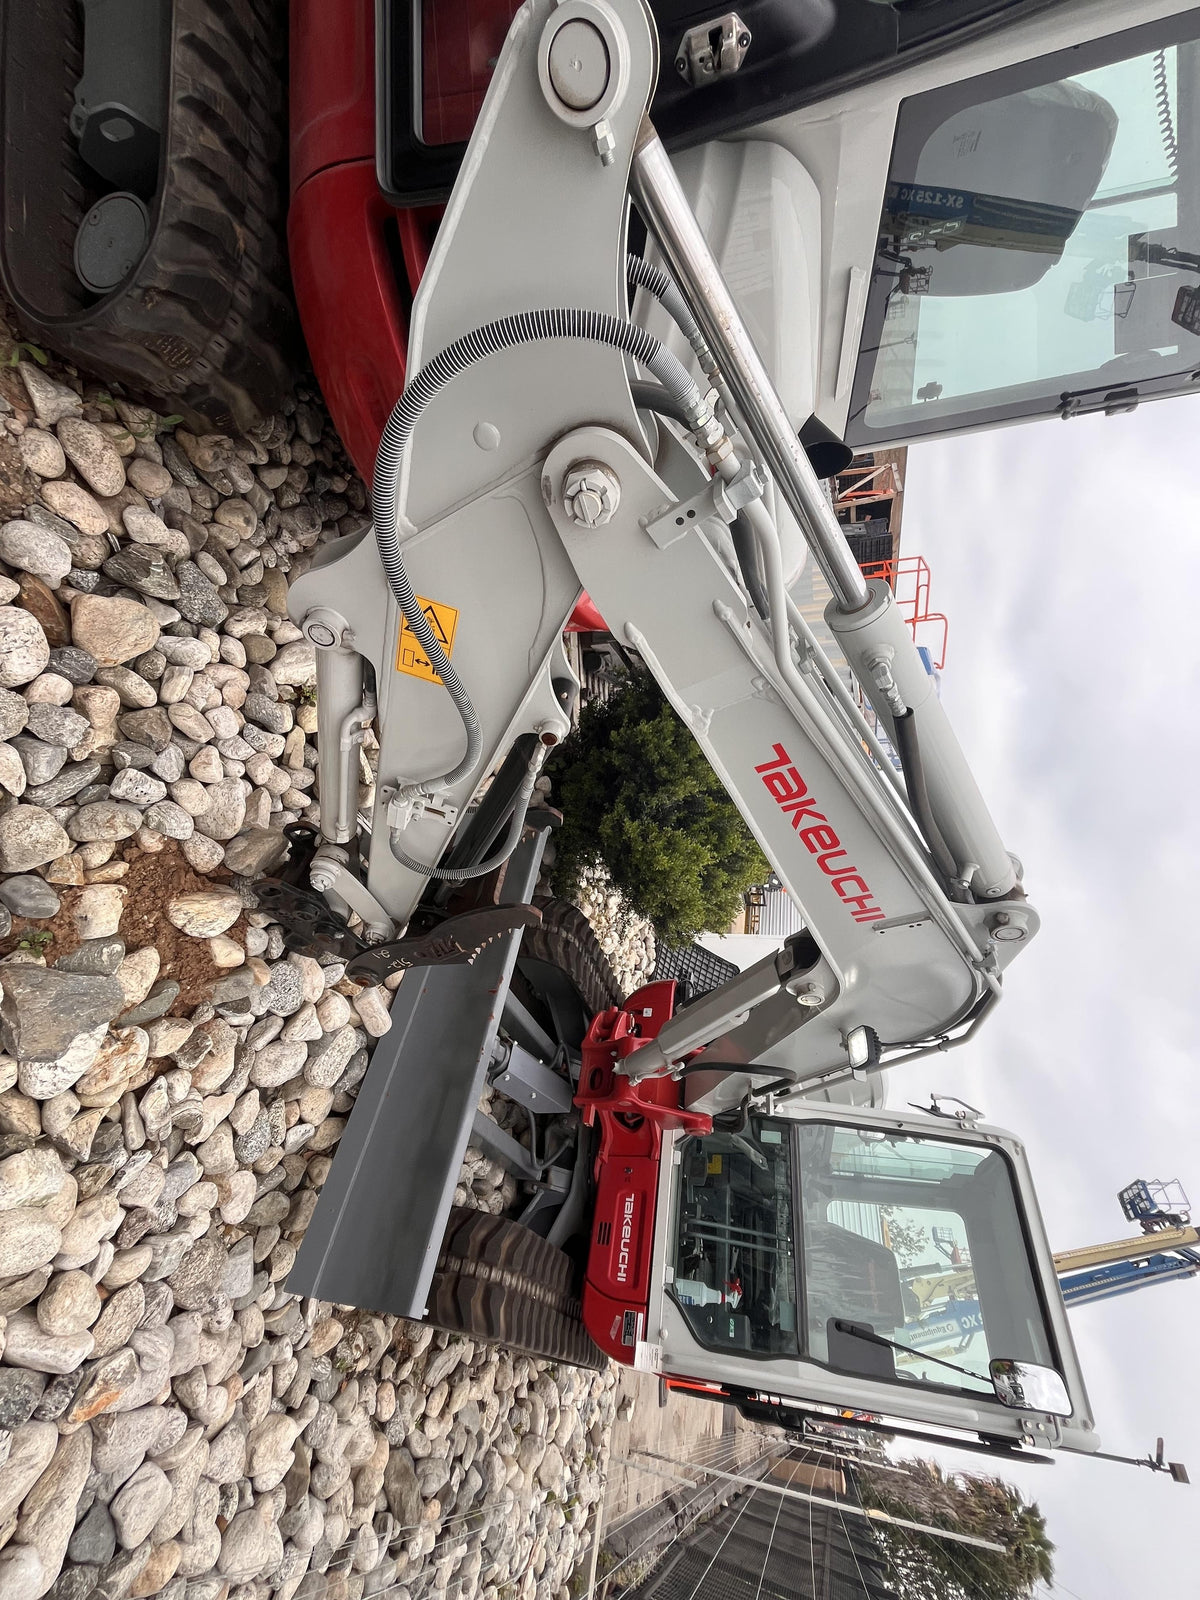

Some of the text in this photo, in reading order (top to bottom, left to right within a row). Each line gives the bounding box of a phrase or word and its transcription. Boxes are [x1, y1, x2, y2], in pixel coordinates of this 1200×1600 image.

[754, 743, 886, 923] TAKEUCHI
[617, 1193, 634, 1282] TAKEUCHI
[961, 1314, 977, 1328] XC
